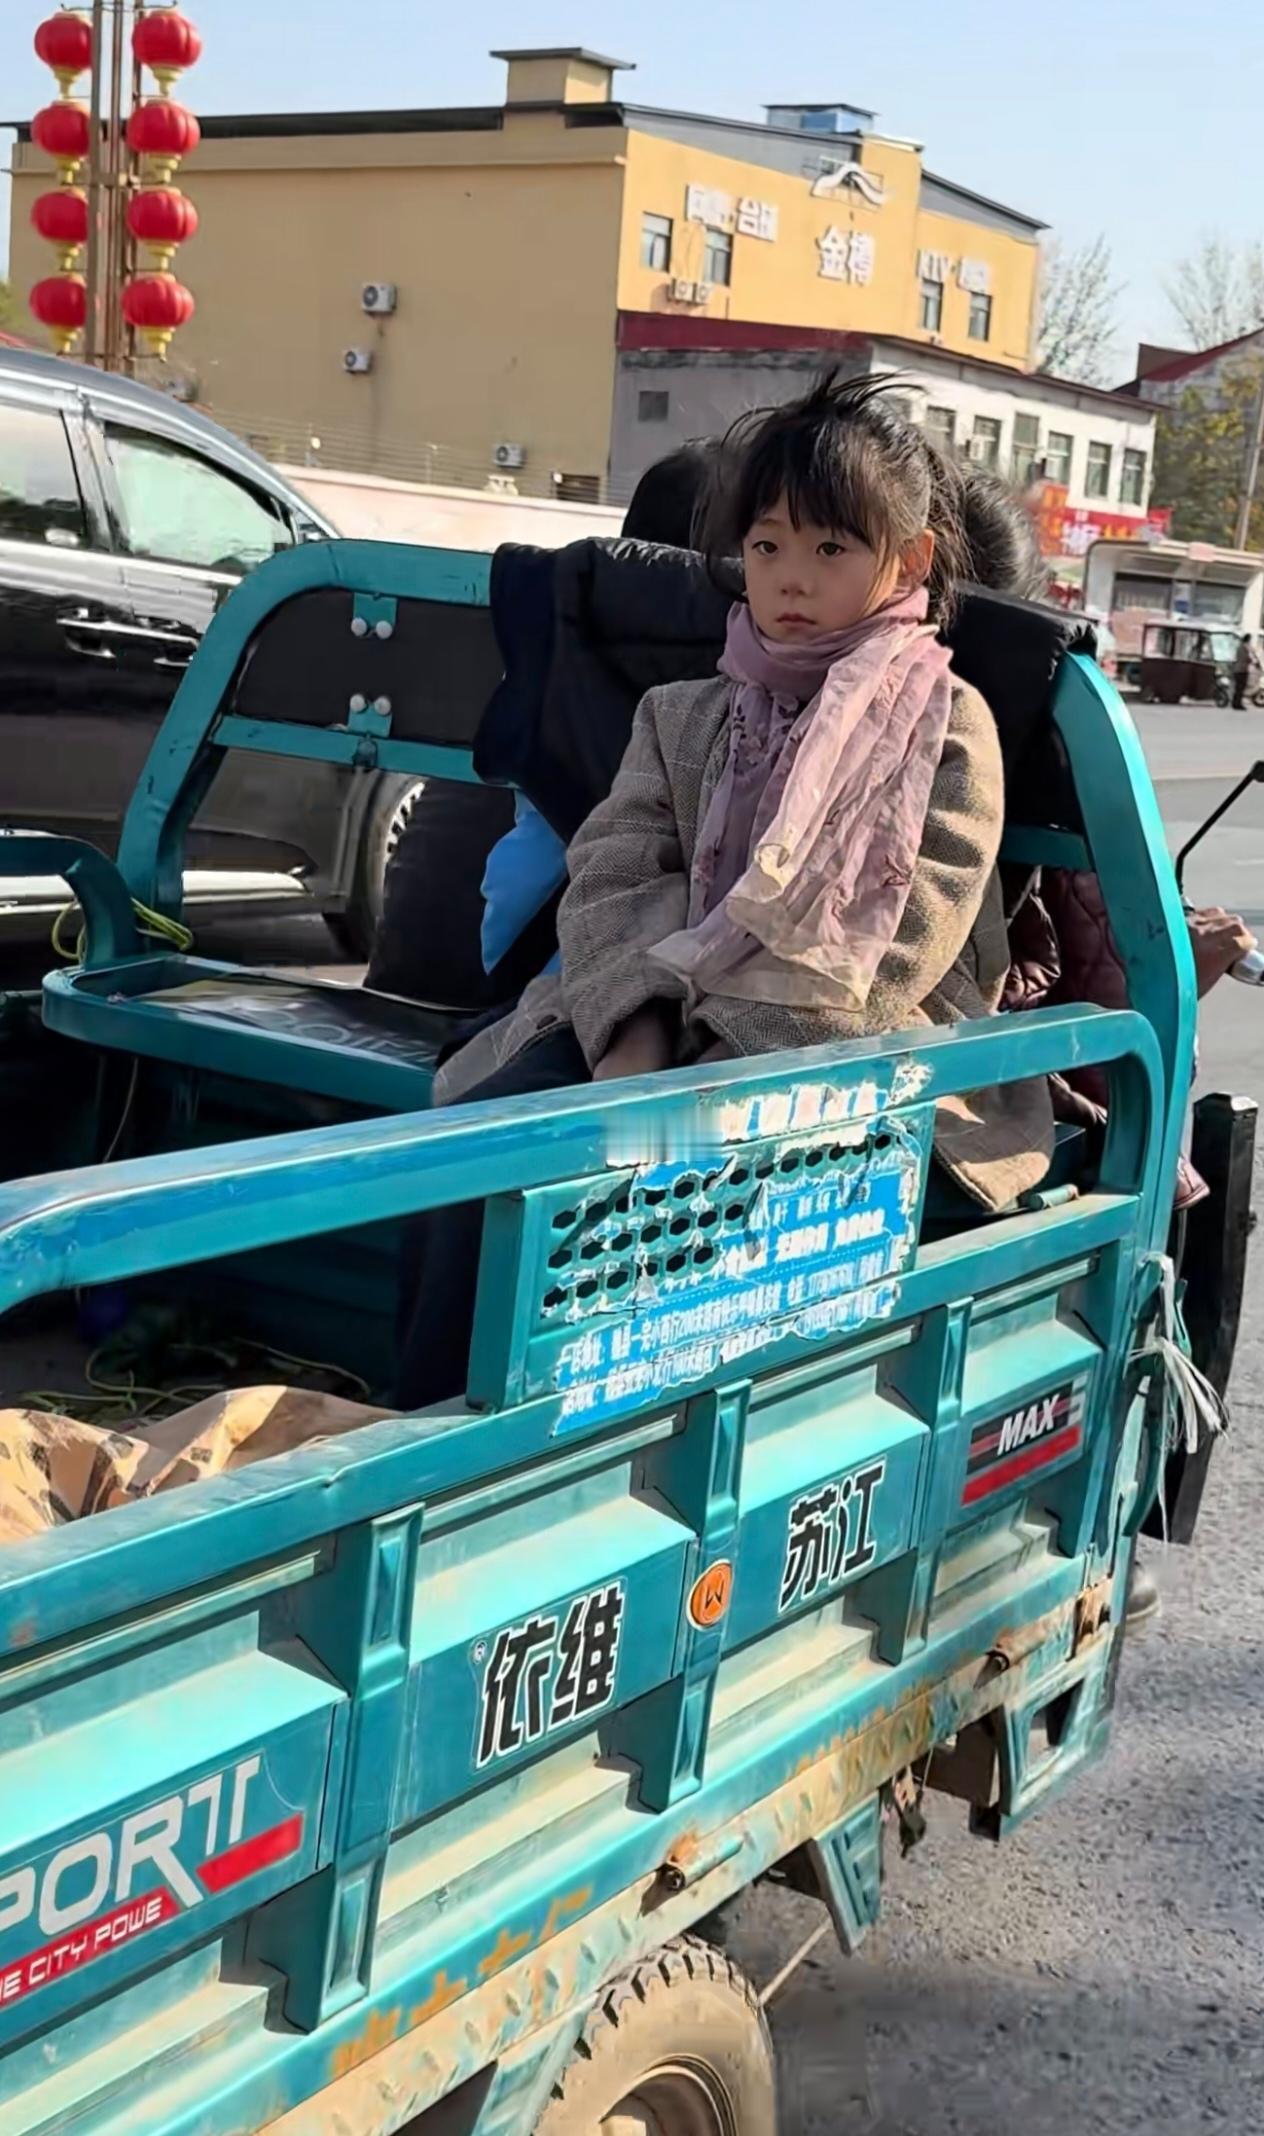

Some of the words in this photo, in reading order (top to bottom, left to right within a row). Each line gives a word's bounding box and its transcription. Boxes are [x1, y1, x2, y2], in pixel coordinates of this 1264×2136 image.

[997, 1393, 1060, 1456] MAX
[779, 1460, 887, 1613] 苏江
[476, 1581, 626, 1769] 依维
[0, 1969, 22, 1999] E
[28, 1933, 88, 1986] CITY
[93, 1896, 164, 1951] POWE
